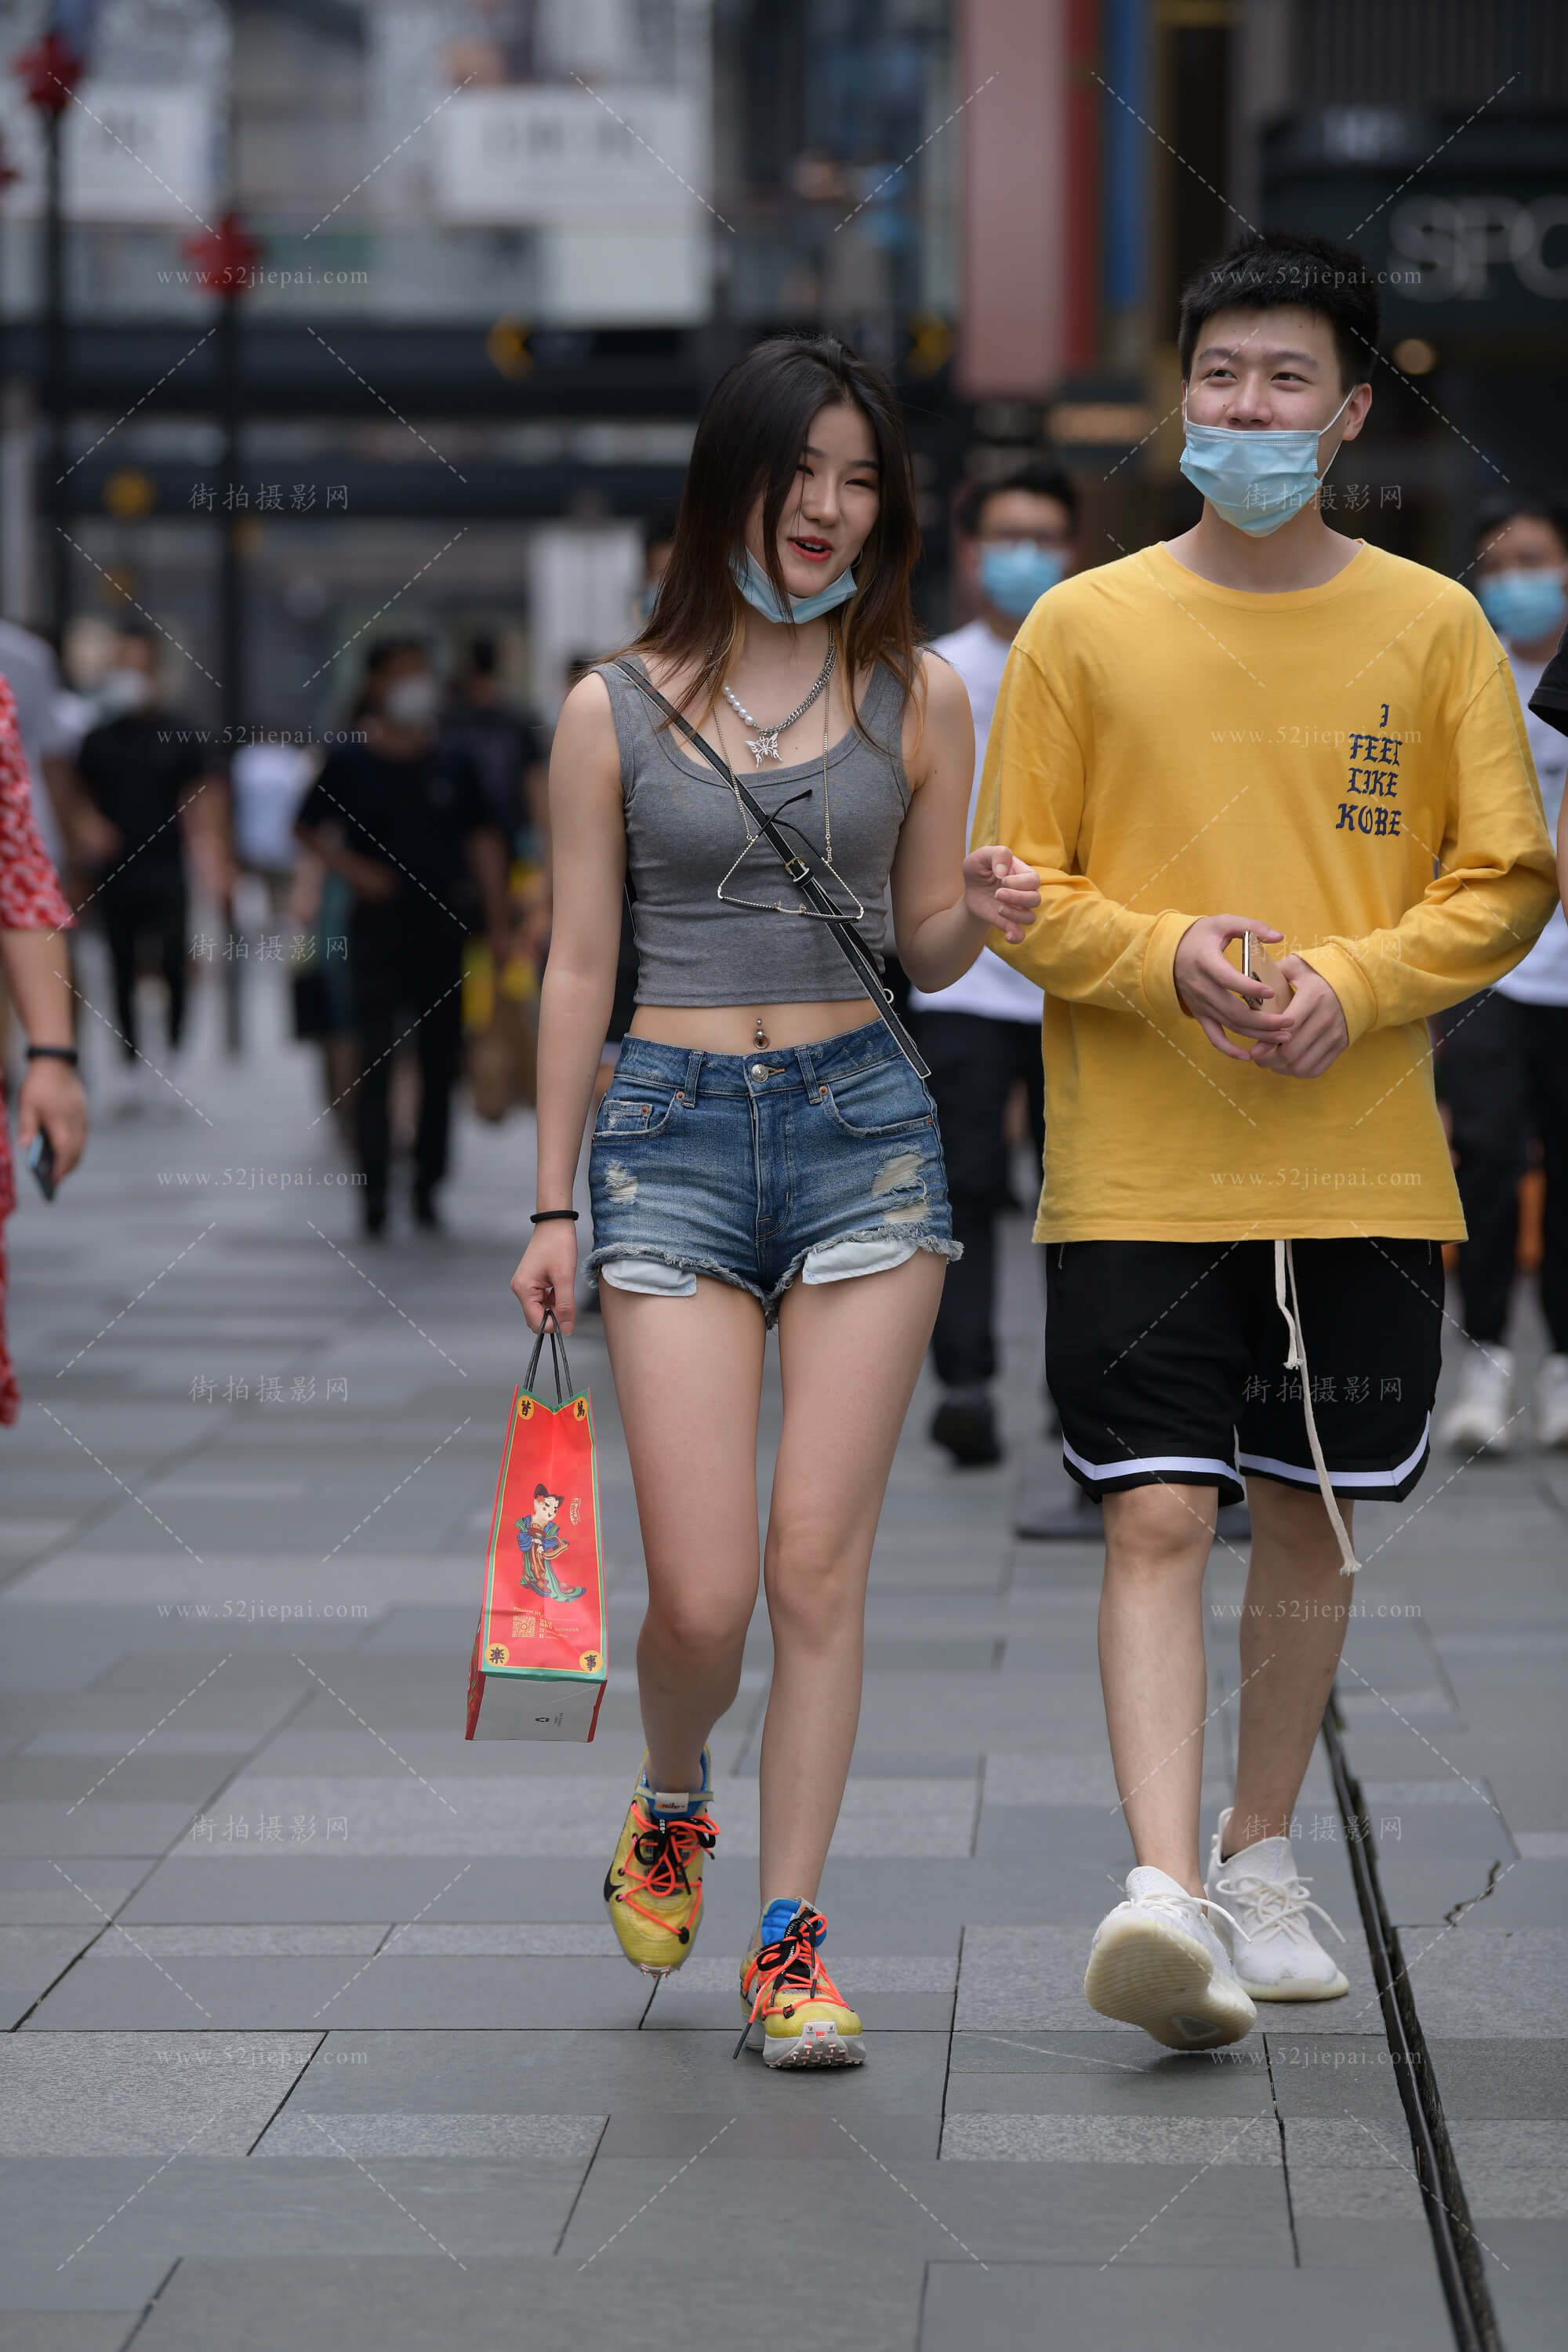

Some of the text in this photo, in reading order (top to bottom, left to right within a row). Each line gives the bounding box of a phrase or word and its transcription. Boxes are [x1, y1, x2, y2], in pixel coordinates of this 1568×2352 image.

[1380, 703, 1389, 728] I
[1347, 768, 1399, 797] LIKE
[1335, 804, 1402, 837] KOBE
[584, 1655, 597, 1671] 事
